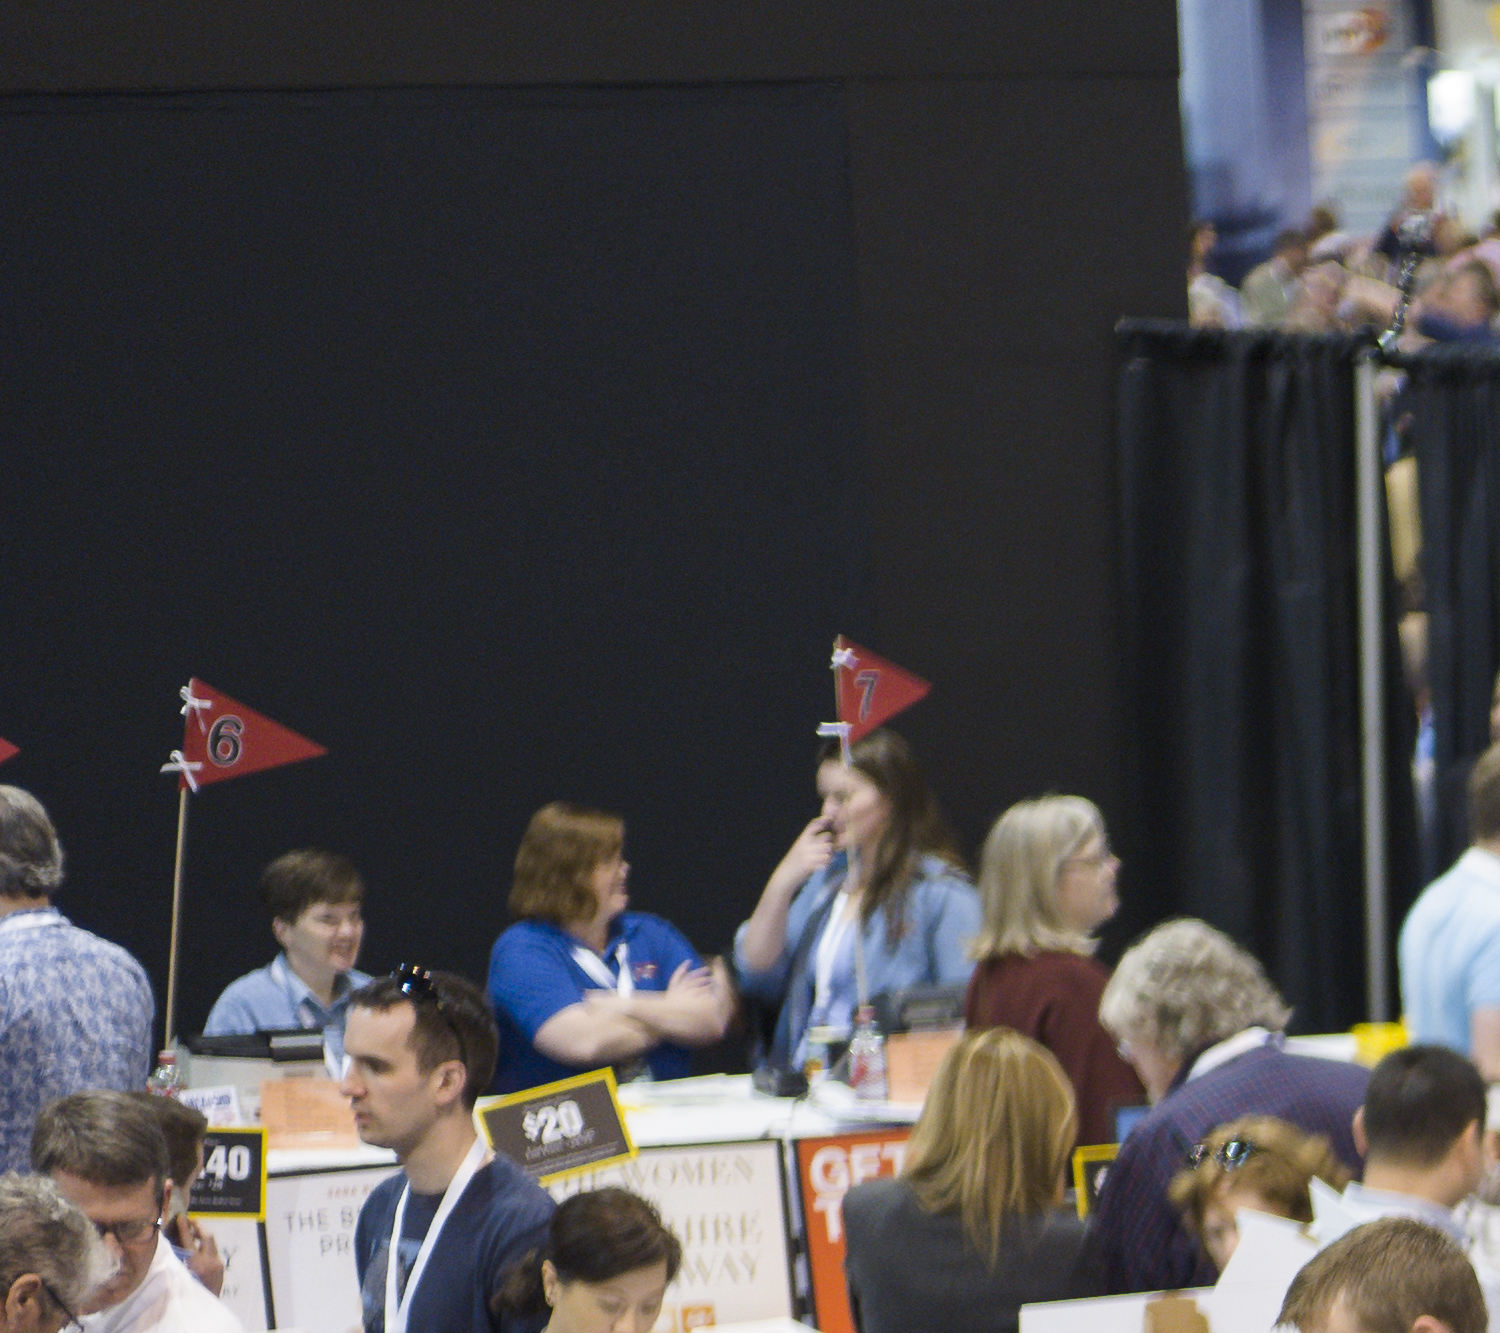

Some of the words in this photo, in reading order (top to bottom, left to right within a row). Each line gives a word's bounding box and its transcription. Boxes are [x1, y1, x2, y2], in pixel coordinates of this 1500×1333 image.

[852, 669, 880, 722] 7
[207, 714, 246, 768] 6
[521, 1100, 585, 1146] $20
[620, 1154, 755, 1192] WOMEN
